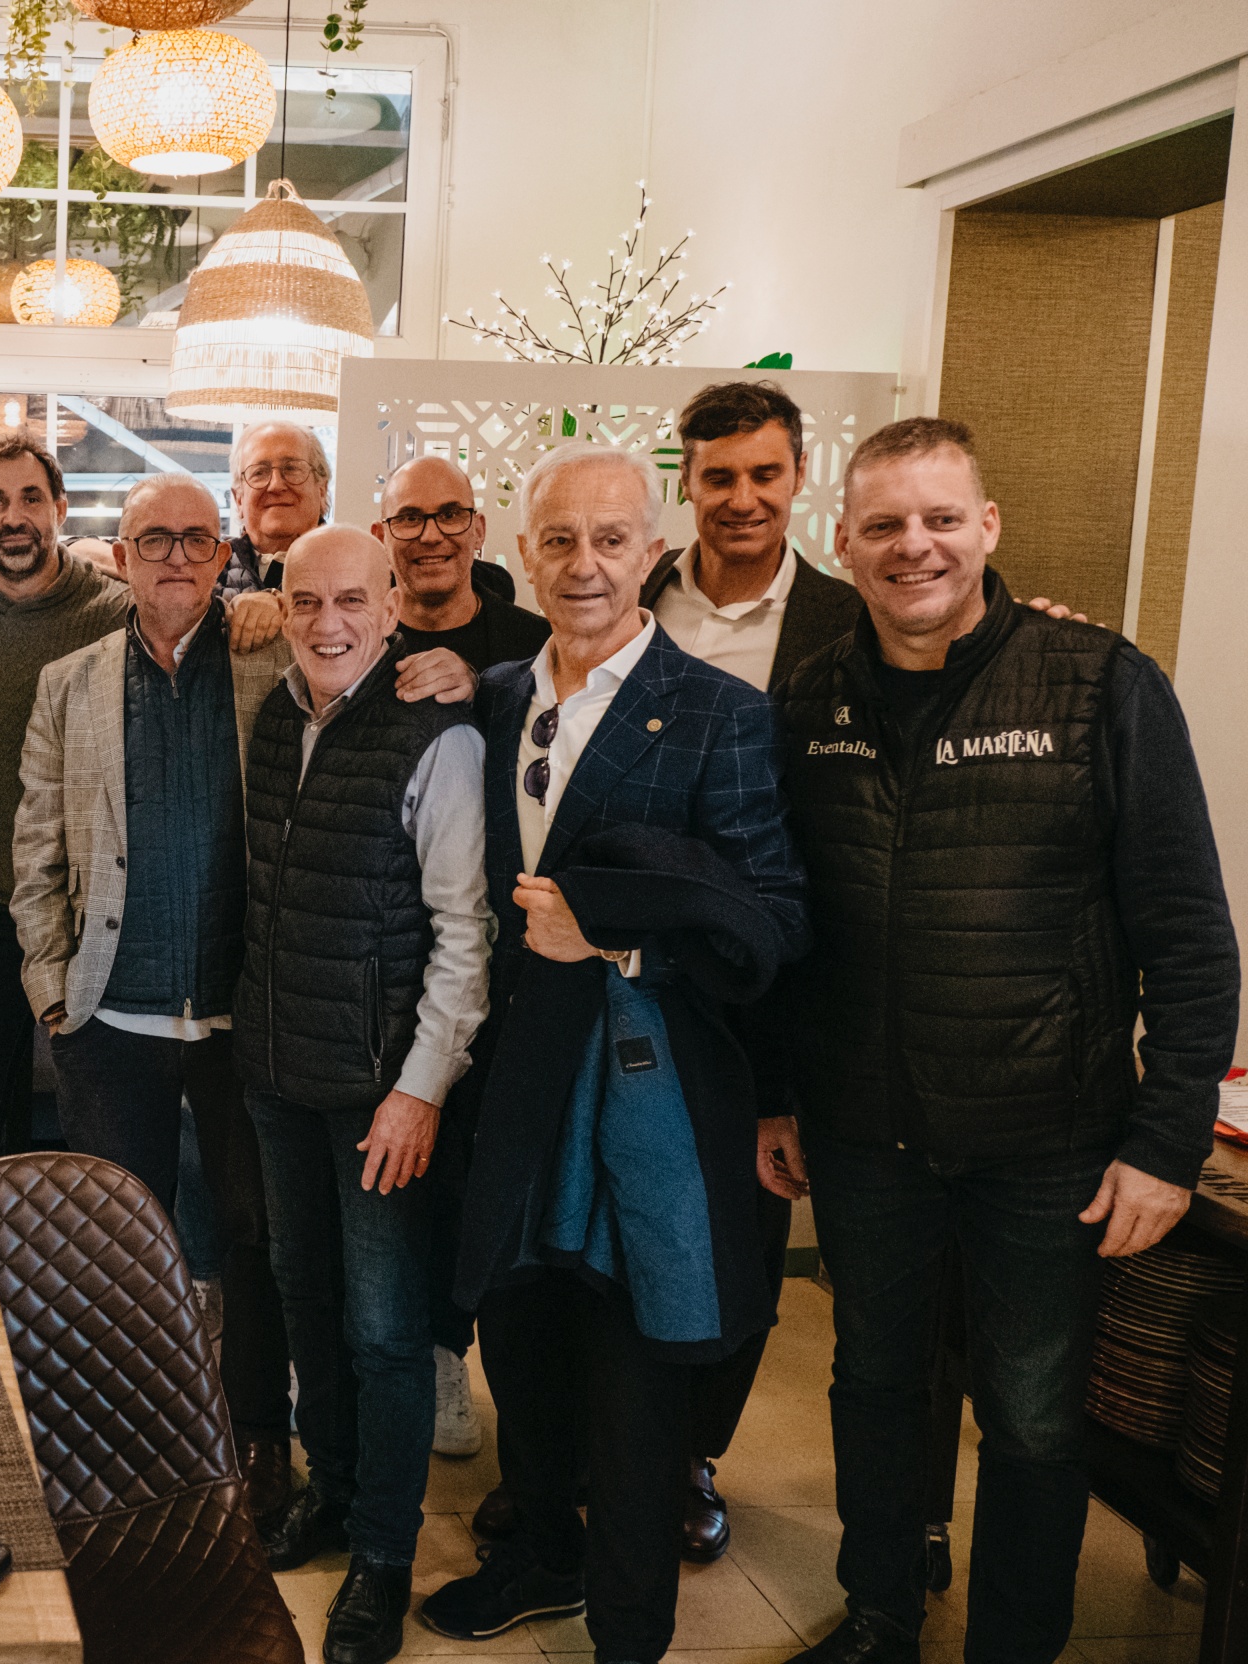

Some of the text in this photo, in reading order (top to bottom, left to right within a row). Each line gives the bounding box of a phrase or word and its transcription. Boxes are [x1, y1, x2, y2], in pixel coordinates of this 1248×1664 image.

[806, 740, 877, 759] Eventalba
[935, 729, 1055, 765] LA MARTEÑA
